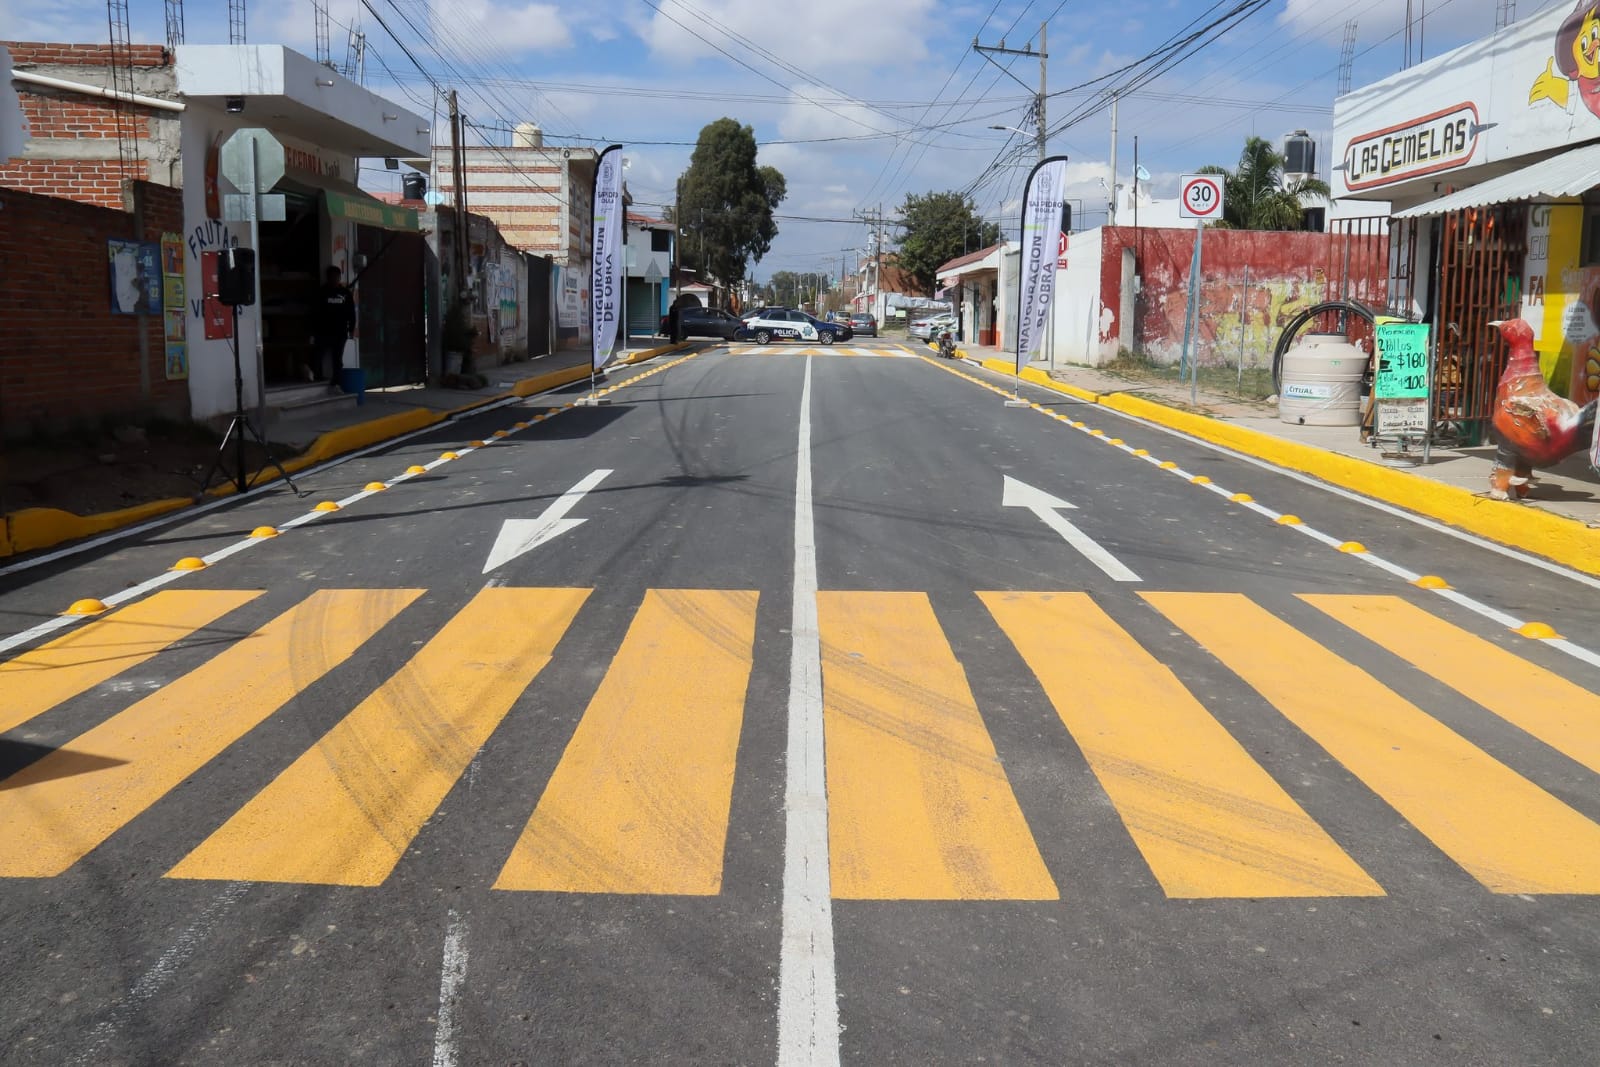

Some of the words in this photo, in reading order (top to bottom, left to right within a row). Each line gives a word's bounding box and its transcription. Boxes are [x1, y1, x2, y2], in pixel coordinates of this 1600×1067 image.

[1351, 144, 1379, 181] LAS
[1192, 186, 1211, 202] 30
[604, 253, 613, 297] OBRA
[1038, 262, 1054, 305] OBRA
[603, 302, 614, 322] DE
[1036, 308, 1046, 329] DE
[1378, 338, 1385, 352] 2
